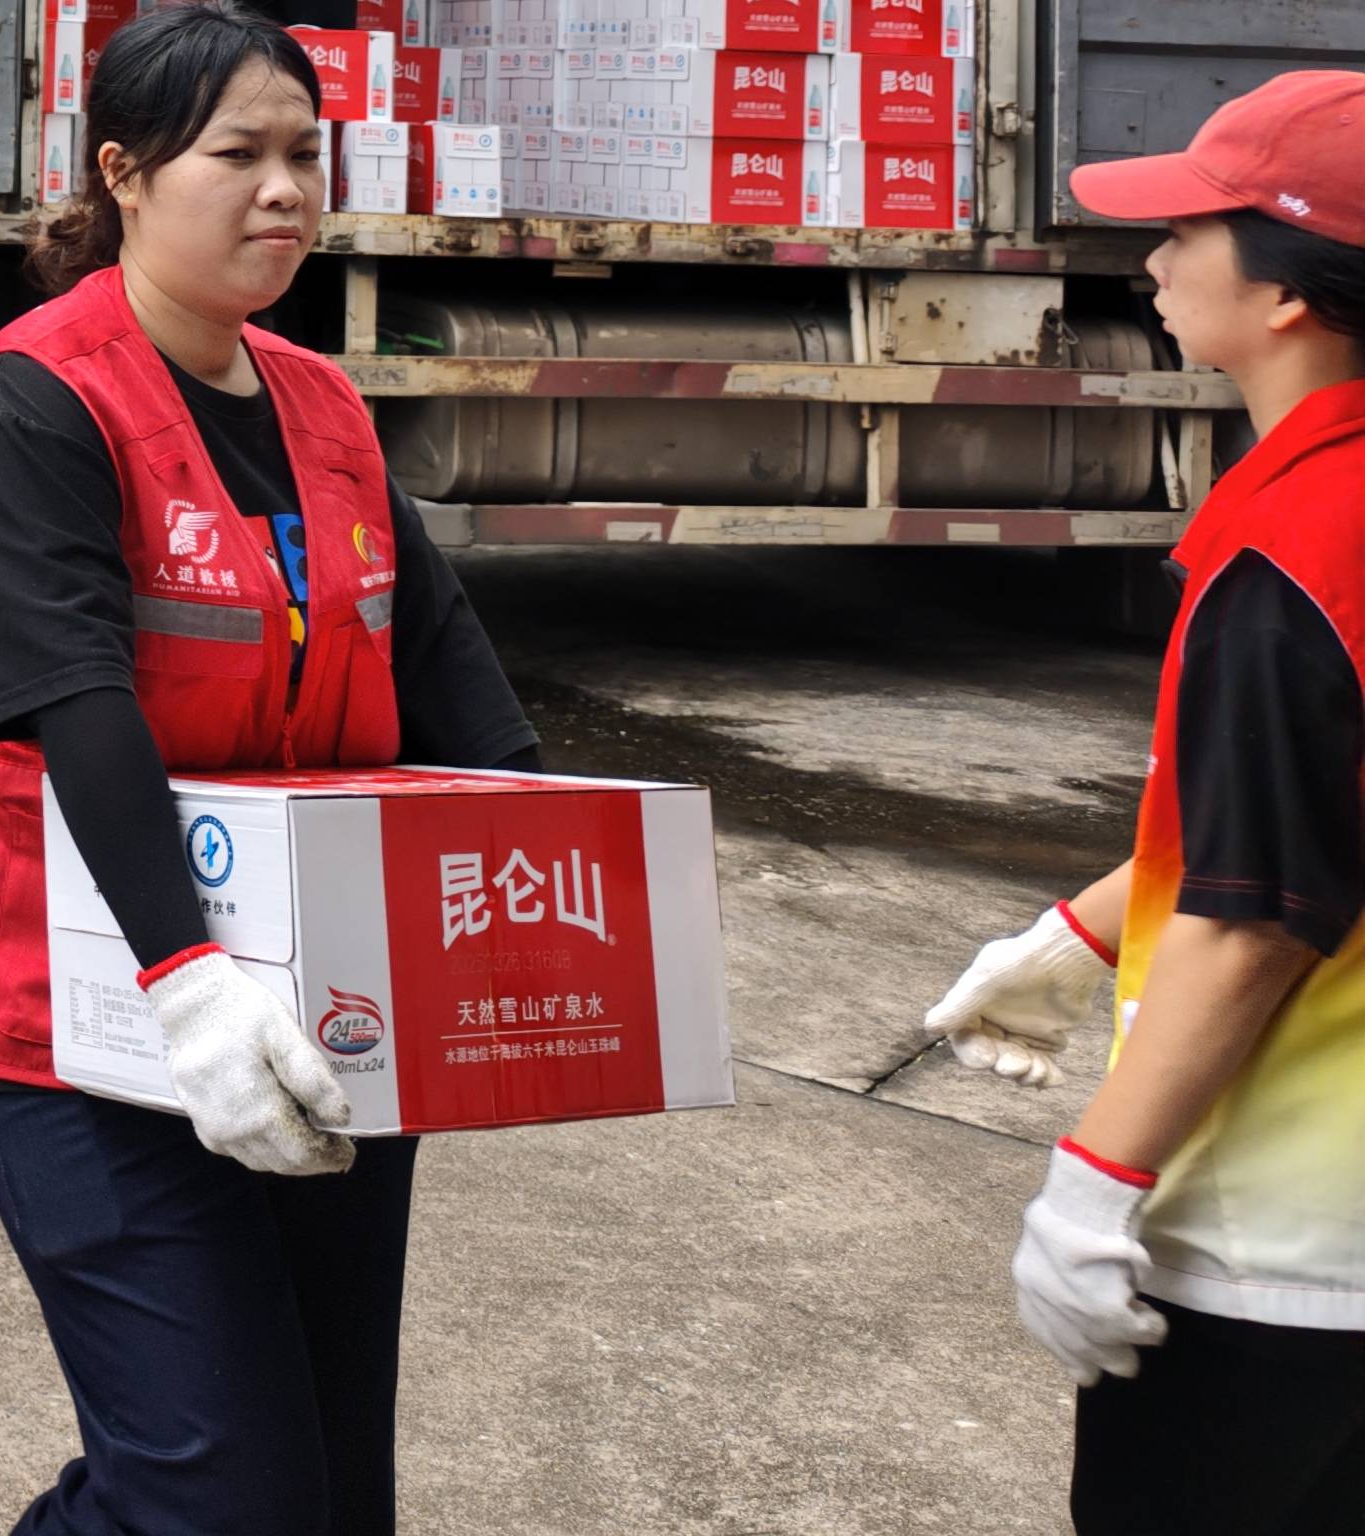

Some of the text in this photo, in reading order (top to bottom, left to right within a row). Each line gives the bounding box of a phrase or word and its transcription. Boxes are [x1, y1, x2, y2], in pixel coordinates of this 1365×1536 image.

[153, 563, 239, 589] 人道救援
[437, 847, 607, 951] 昆仑山
[457, 991, 605, 1026] 天然雪山矿泉水
[328, 1020, 351, 1042] 24
[445, 1036, 621, 1064] 水源地位于海拔六千米昆仑山玉珠峰
[329, 1056, 386, 1074] 00mLx24
